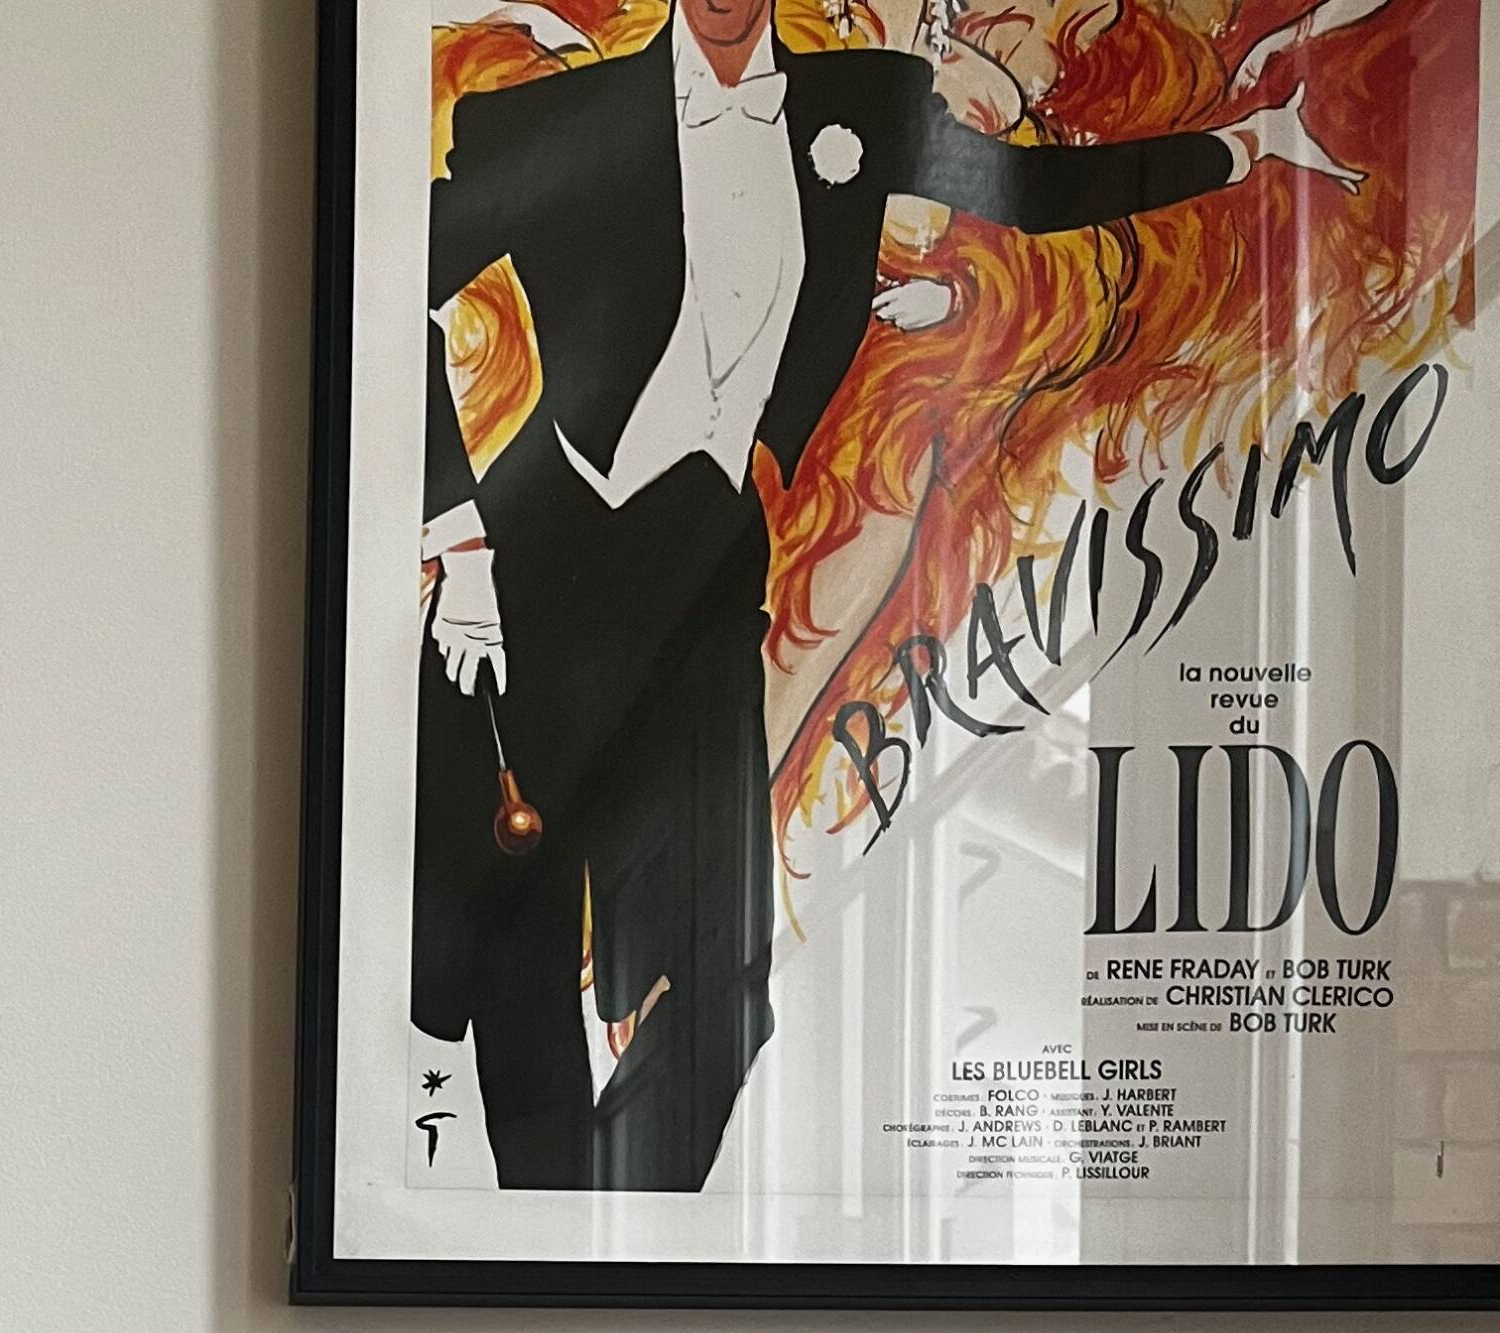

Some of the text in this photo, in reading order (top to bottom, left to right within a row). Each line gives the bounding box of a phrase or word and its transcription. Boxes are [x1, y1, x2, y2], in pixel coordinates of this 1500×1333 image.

[832, 363, 1449, 856] BRAVISSIMO
[1179, 661, 1312, 684] la nouvelle
[1209, 690, 1279, 710] revue
[1228, 714, 1260, 736] du
[1083, 739, 1400, 936] LIDO
[1086, 971, 1099, 980] DE
[1107, 959, 1163, 980] RENE
[1170, 959, 1259, 980] FRADAY
[1283, 959, 1330, 980] BOB
[1336, 959, 1392, 981] TURK
[1145, 997, 1159, 1006] DE
[1165, 985, 1285, 1006] CHRISTIAN
[1292, 986, 1394, 1008] CLERICO
[1136, 1023, 1159, 1031] MISE
[1161, 1023, 1175, 1031] EN
[1210, 1023, 1222, 1031] DE
[1230, 1013, 1276, 1032] BOB
[1283, 1013, 1337, 1033] TURK
[1042, 1044, 1072, 1054] AVEC
[952, 1060, 1162, 1081] LES BLUEBELL GIRLS
[988, 1089, 1040, 1102] FOLCO
[1103, 1088, 1112, 1101] J.
[1117, 1088, 1177, 1101] HARBERT
[980, 1104, 992, 1117] B.
[995, 1104, 1038, 1117] RANG
[1101, 1103, 1112, 1117] Y.
[1117, 1103, 1174, 1117] VALENTE
[958, 1120, 969, 1133] J.
[973, 1120, 1041, 1132] ANDREWS
[1053, 1120, 1067, 1132] D.
[1071, 1119, 1132, 1132] LEBLANC
[1150, 1119, 1159, 1132] P.
[1163, 1119, 1227, 1132] RAMBERT
[982, 1135, 1007, 1147] MC
[1011, 1135, 1043, 1147] LAIN
[1139, 1135, 1149, 1148] J.
[1153, 1135, 1201, 1148] BRIANT
[969, 1155, 1015, 1163] DIRECTION
[1088, 1150, 1138, 1164] VIATGE
[957, 1170, 1003, 1179] DIRECTION
[1062, 1168, 1073, 1179] P.
[1076, 1167, 1150, 1179] LISSILLOUR
